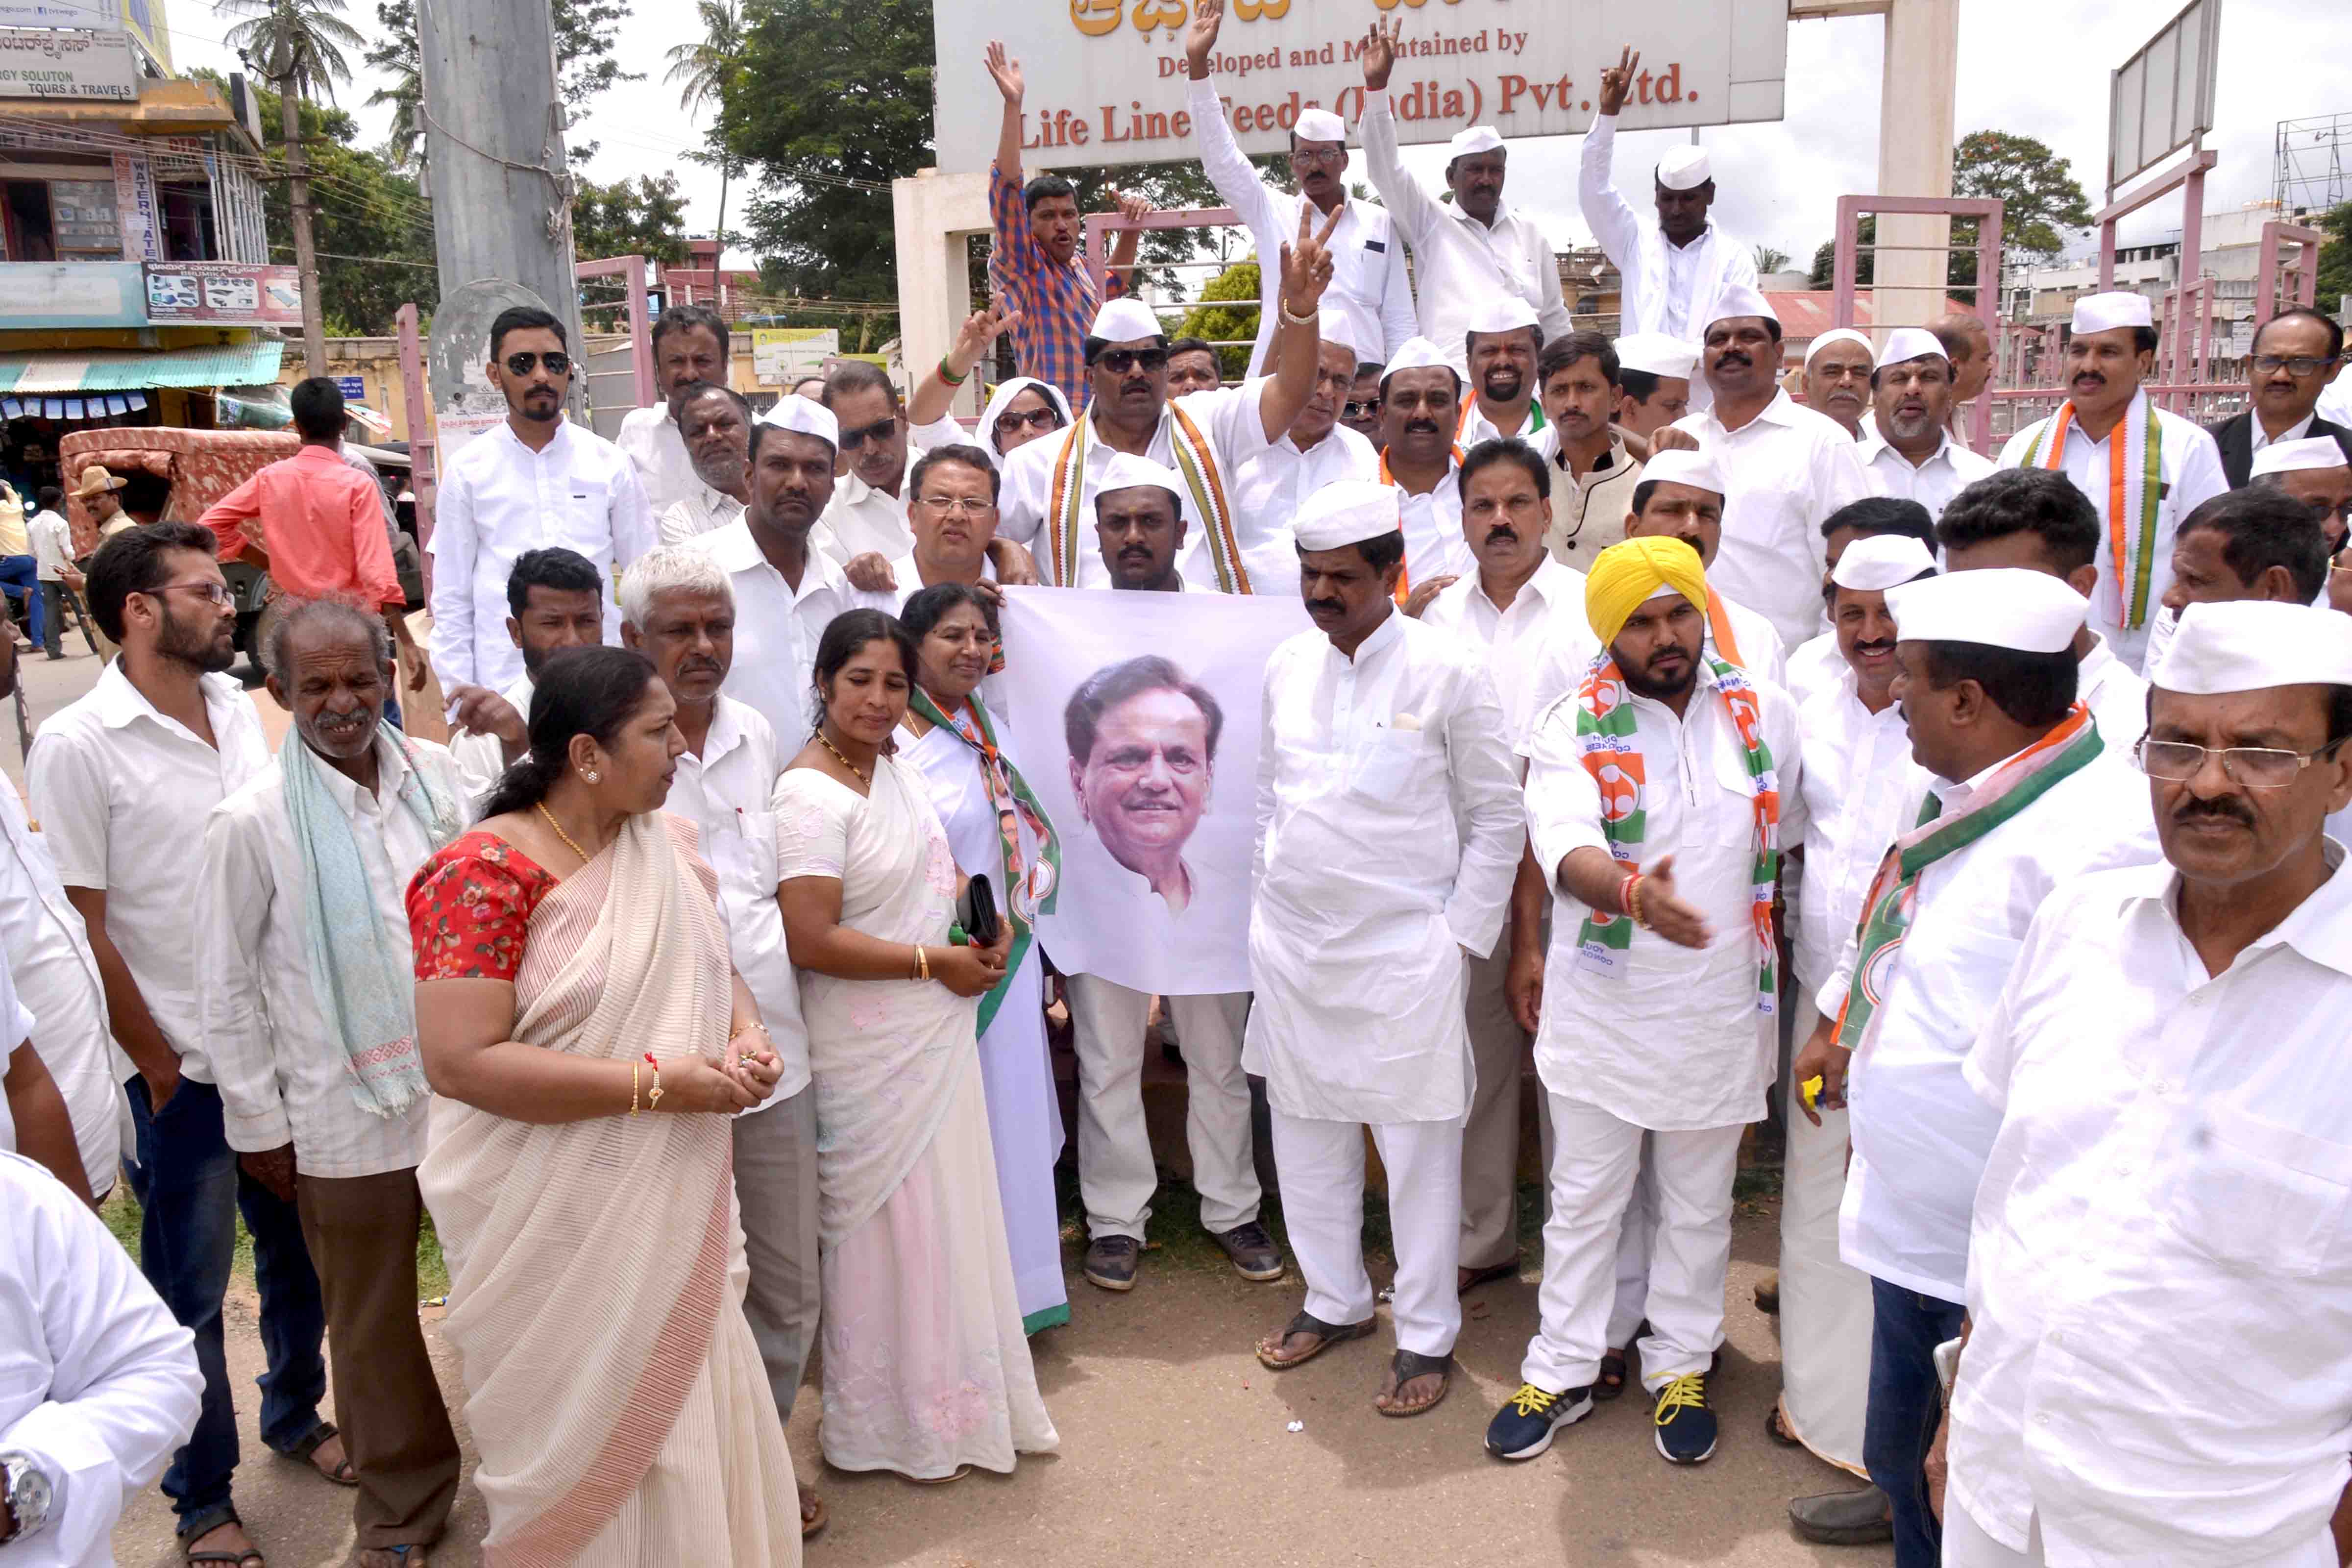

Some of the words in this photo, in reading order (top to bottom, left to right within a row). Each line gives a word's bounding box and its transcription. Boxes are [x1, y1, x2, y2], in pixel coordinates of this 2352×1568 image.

[1157, 47, 1281, 77] Deeloped
[1290, 42, 1334, 66] and
[1343, 30, 1488, 62] Mntained
[1497, 28, 1528, 54] by
[22, 71, 74, 82] SOLUTON
[28, 83, 67, 94] TOURS
[81, 84, 131, 96] TRAVELS
[1020, 109, 1088, 148] Life
[1100, 101, 1191, 142] Line
[1335, 78, 1482, 135] (Idia)
[1497, 73, 1591, 114] Pvt.
[133, 162, 150, 209] WATER
